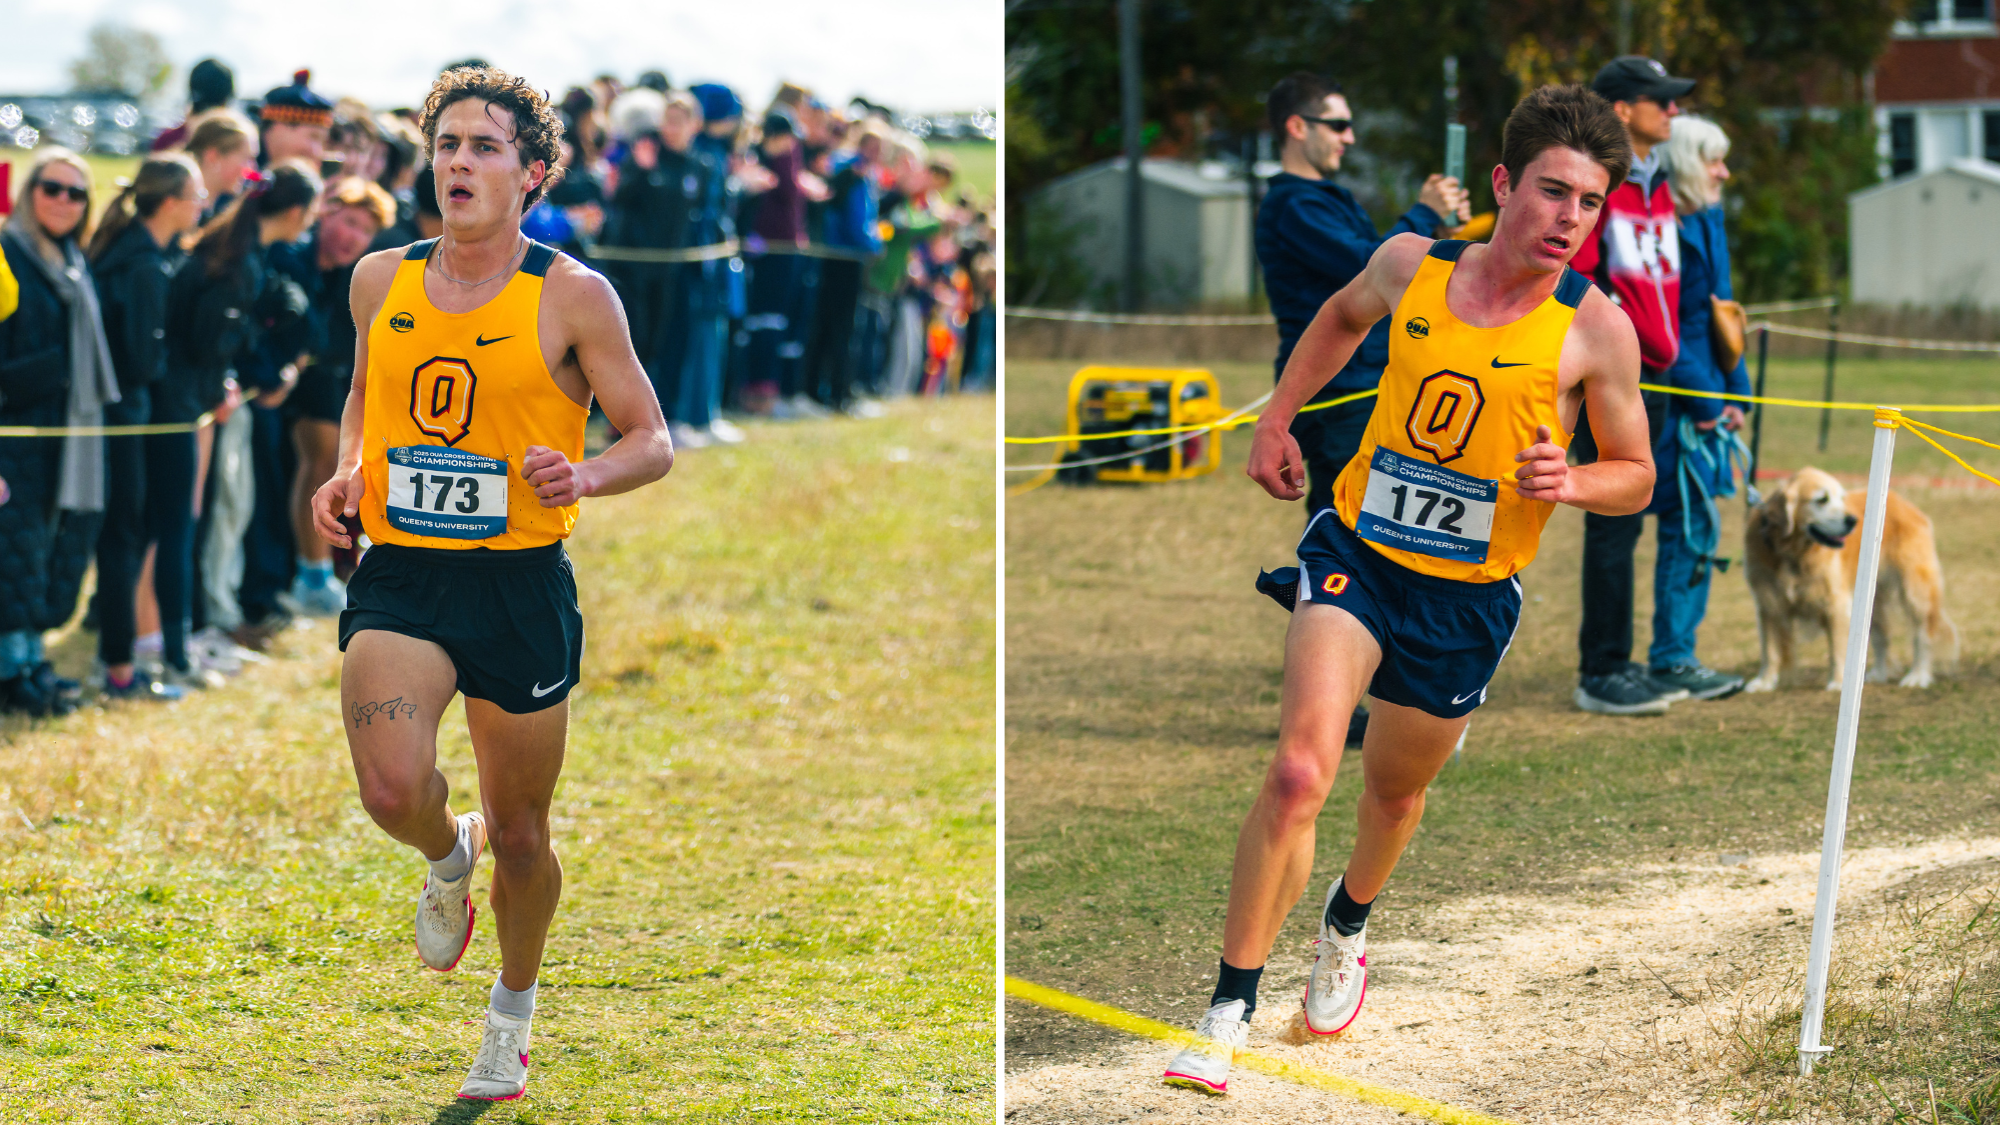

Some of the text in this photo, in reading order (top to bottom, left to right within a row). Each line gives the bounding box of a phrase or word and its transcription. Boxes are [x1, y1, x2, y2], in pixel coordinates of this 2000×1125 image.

[389, 317, 414, 329] OUA
[1406, 321, 1429, 336] OUA
[409, 356, 477, 447] Q
[1405, 369, 1486, 465] Q
[412, 456, 498, 470] CHAMPIONSHIPS
[1400, 461, 1418, 470] 2025
[1418, 466, 1432, 474] OUA
[1433, 470, 1455, 481] CROSS
[1455, 478, 1488, 490] COUNTRY
[409, 472, 480, 514] 173
[1399, 467, 1487, 496] CHAMPIONSHIPS
[398, 516, 489, 531] QUEEN'S UNIVERSITY
[1391, 484, 1466, 535] 172
[1372, 524, 1470, 552] QUEEN'S UNIVERSITY
[1321, 572, 1351, 596] Q
